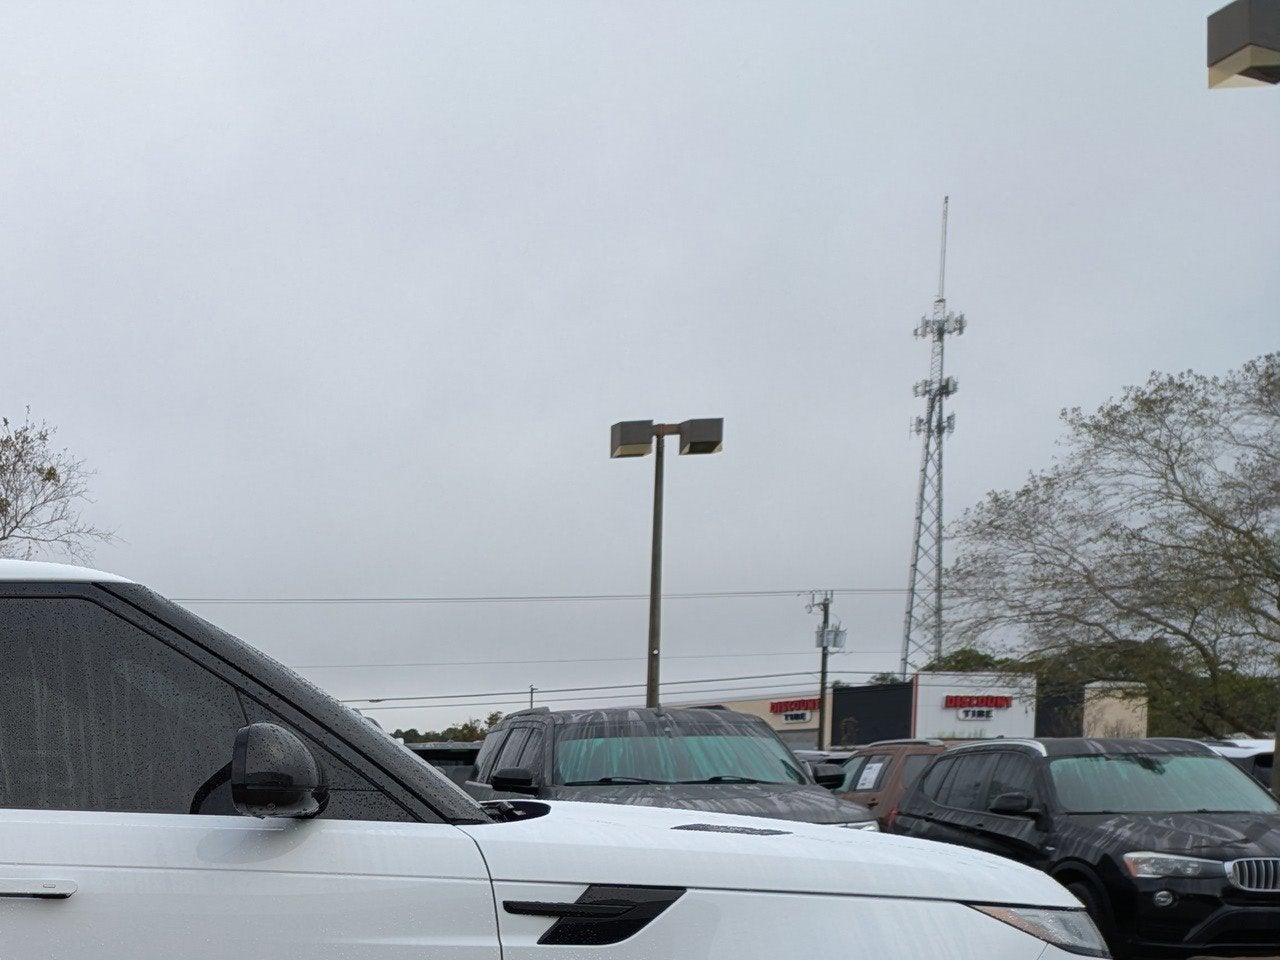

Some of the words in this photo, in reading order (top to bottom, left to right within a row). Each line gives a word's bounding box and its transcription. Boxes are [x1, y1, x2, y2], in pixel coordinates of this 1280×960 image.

[945, 695, 1013, 708] DISCOUNT
[784, 712, 807, 721] TIRE
[963, 709, 993, 718] TIRE
